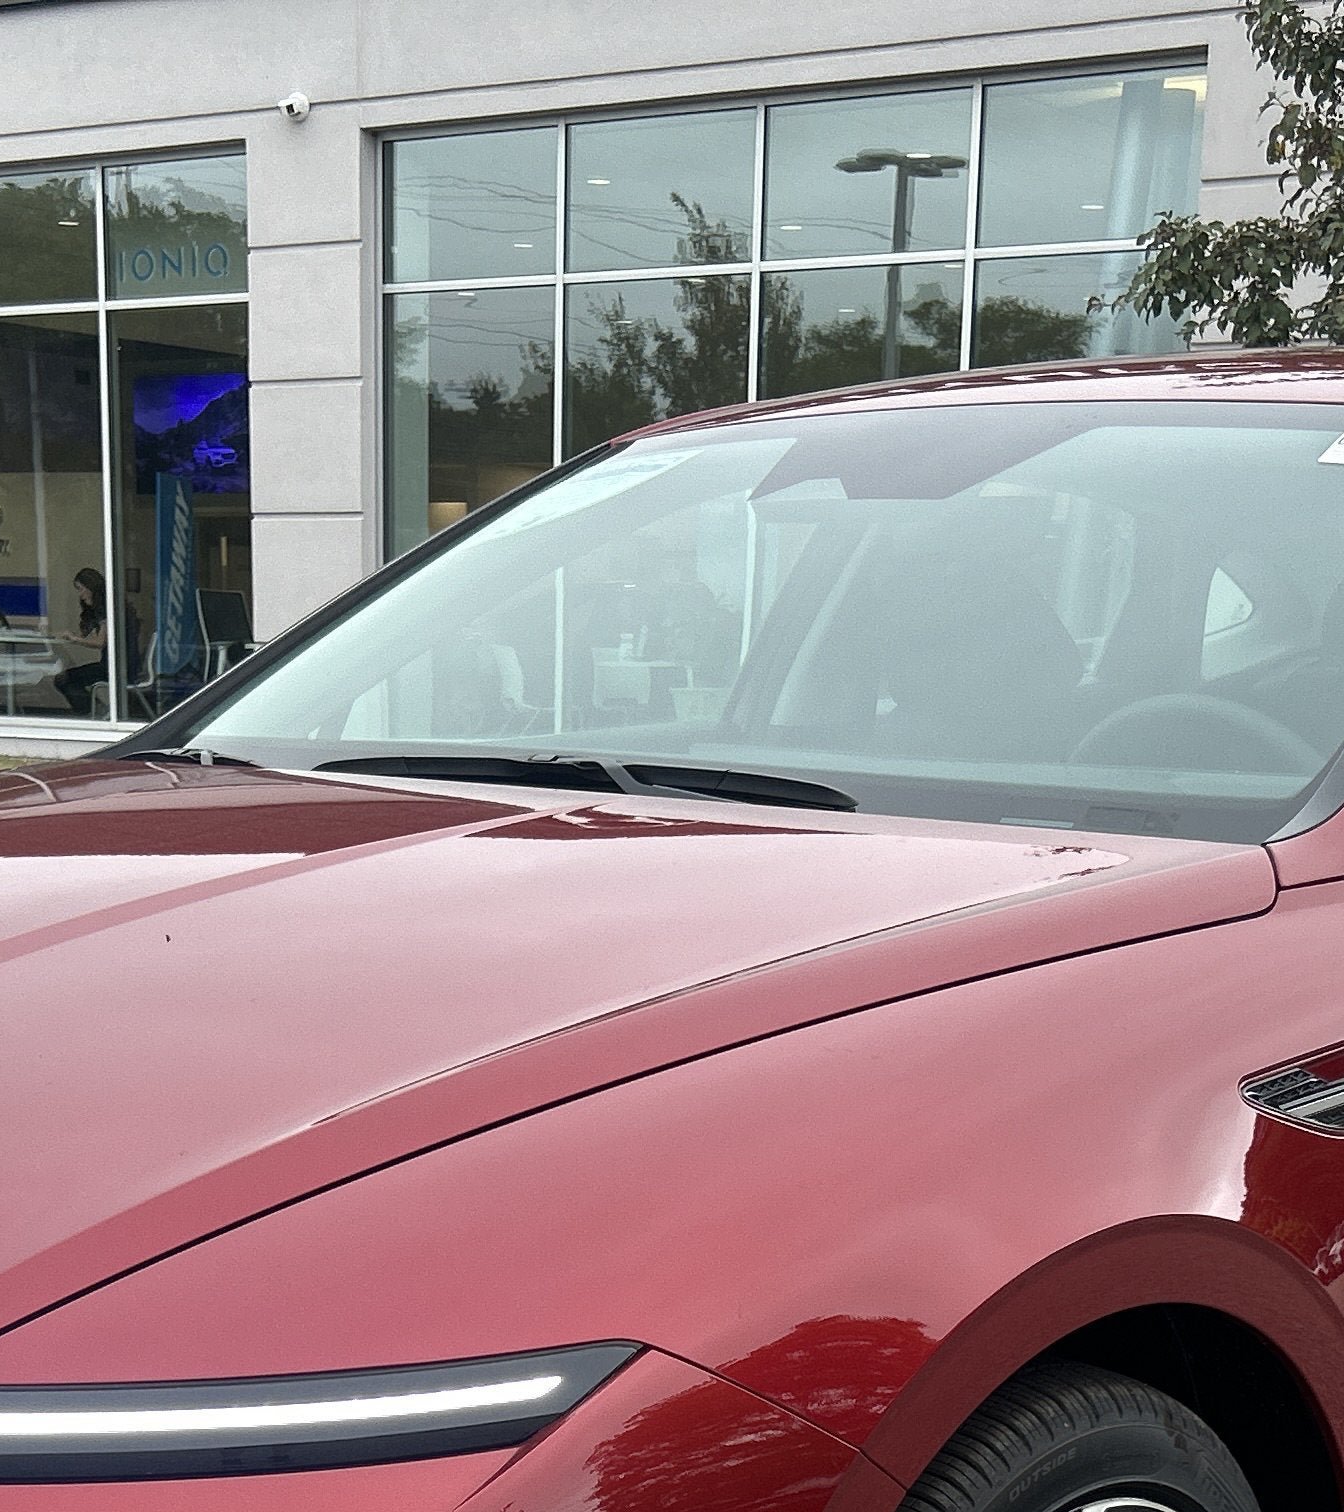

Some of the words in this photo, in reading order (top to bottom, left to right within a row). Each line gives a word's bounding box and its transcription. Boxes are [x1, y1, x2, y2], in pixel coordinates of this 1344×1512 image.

[119, 242, 229, 282] IONIQ
[164, 480, 189, 663] GETAWAY
[1008, 1447, 1077, 1502] OUTSIDE
